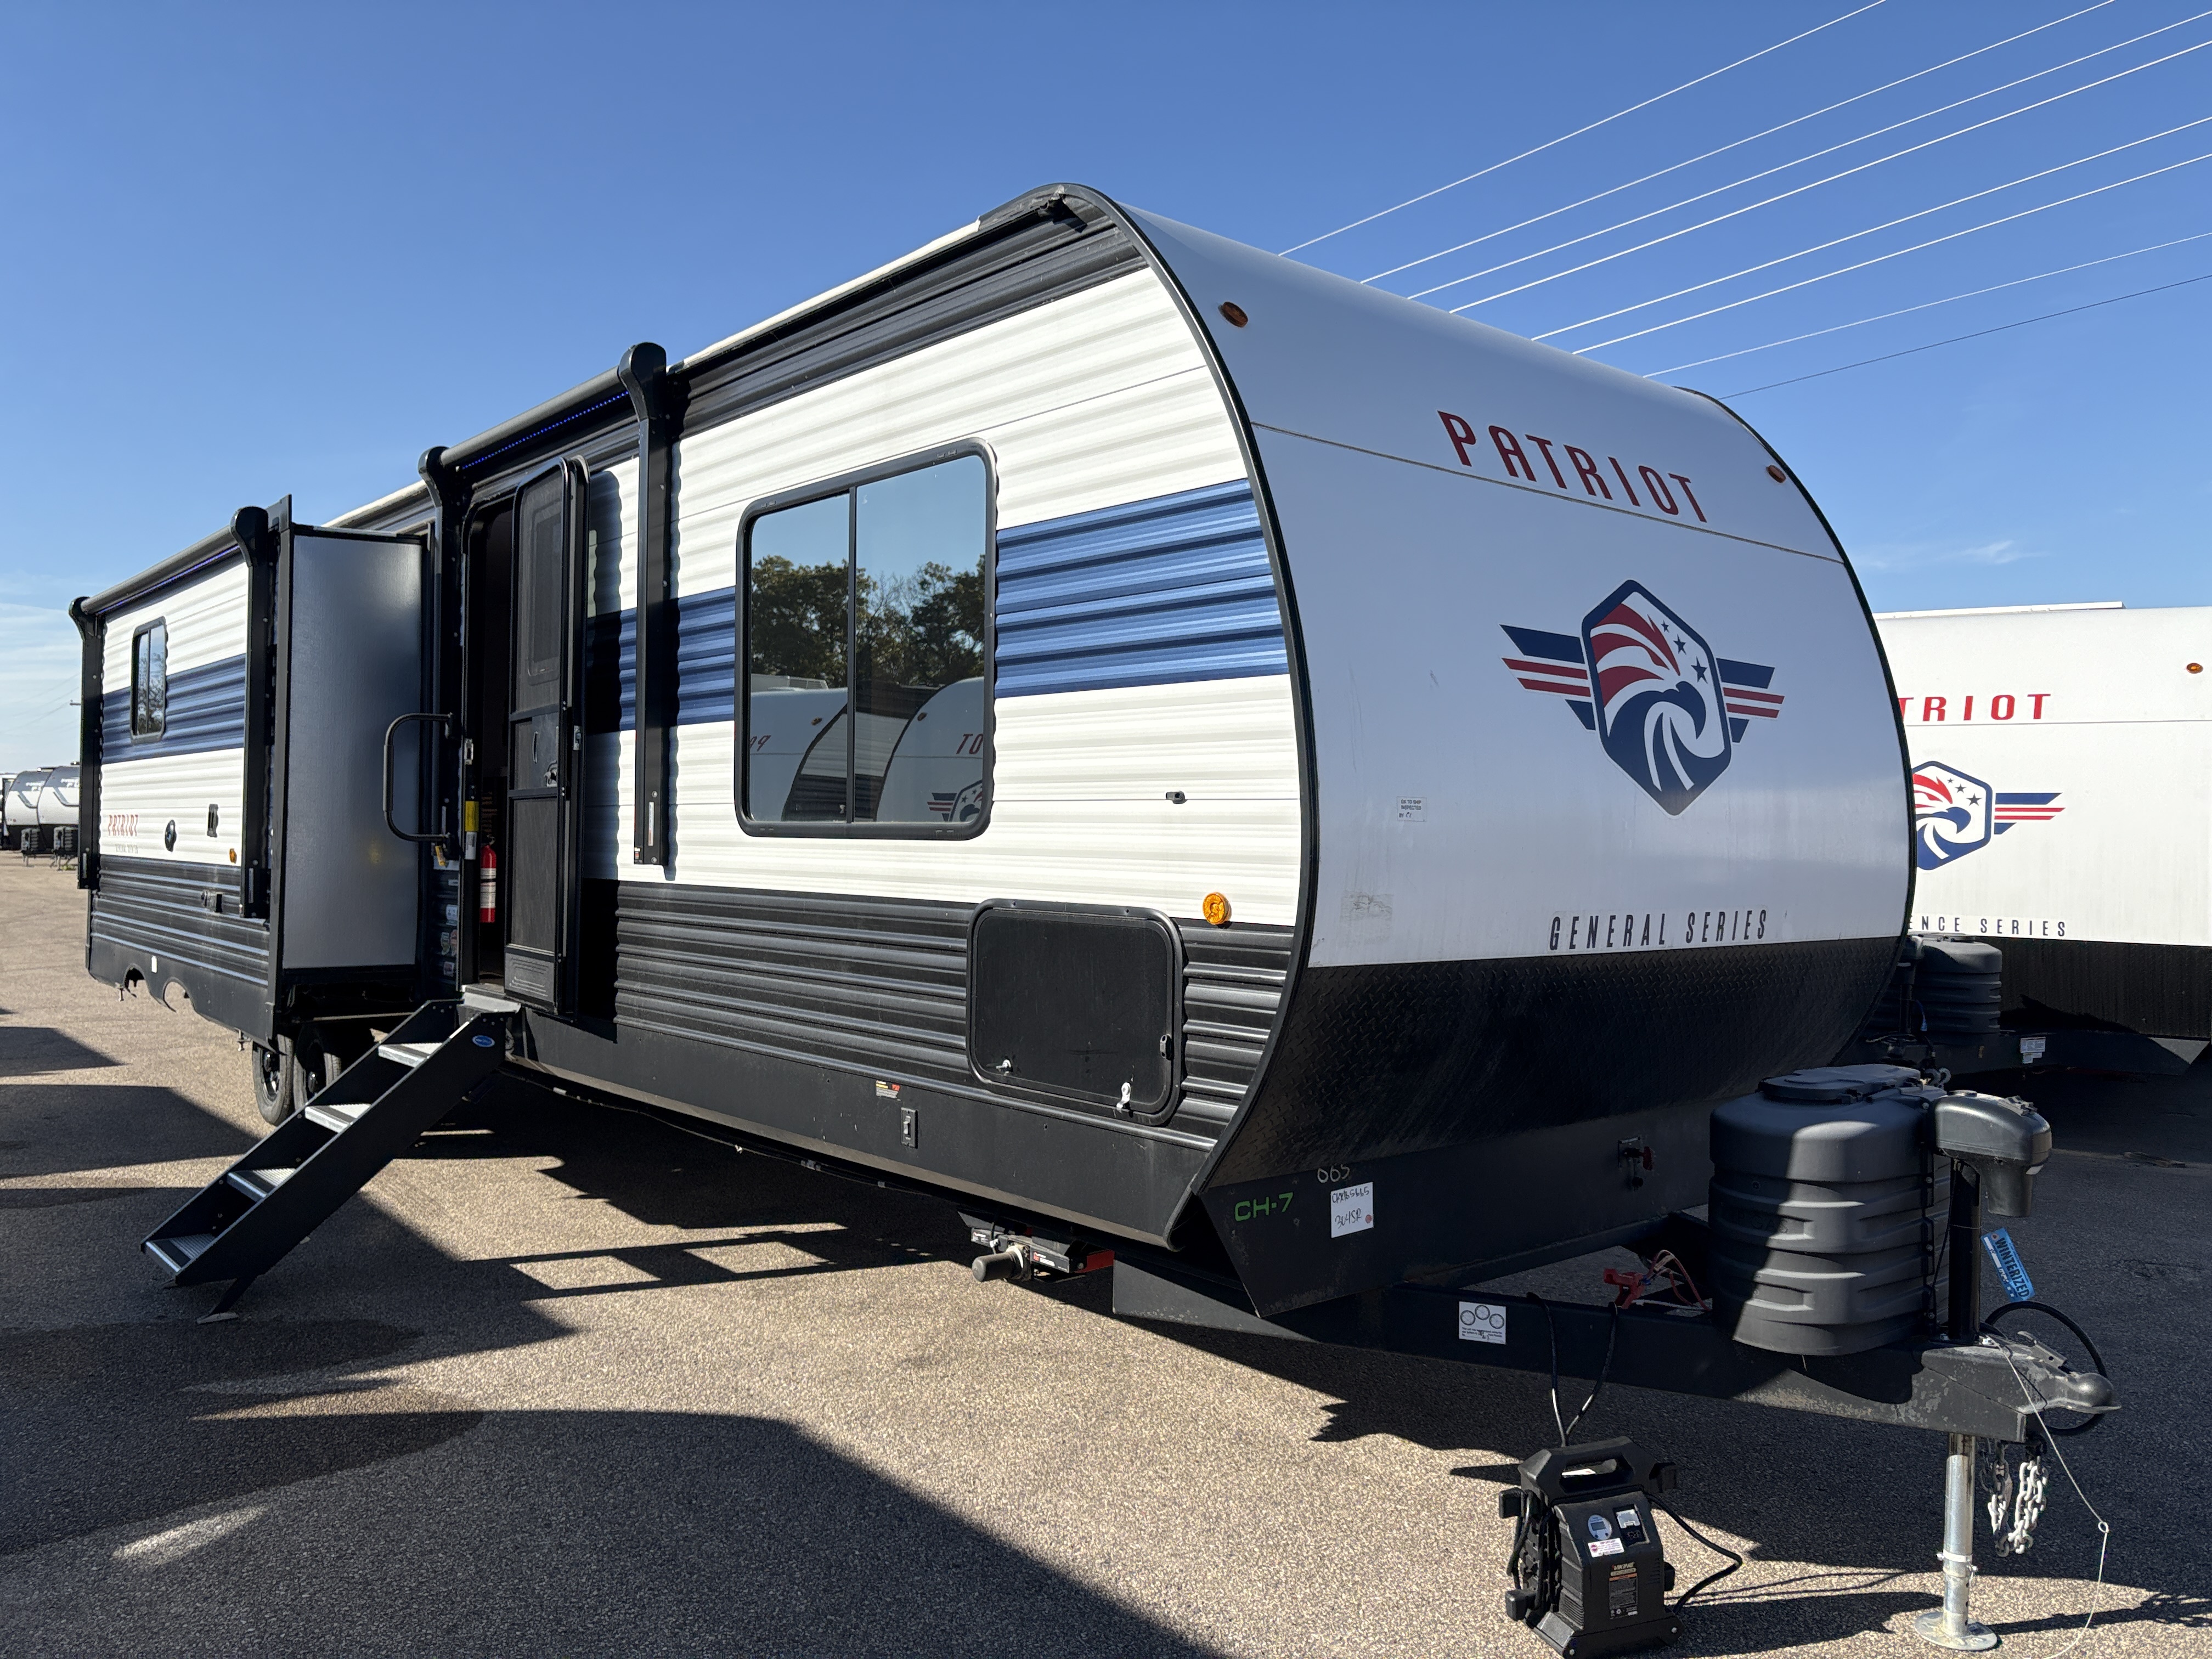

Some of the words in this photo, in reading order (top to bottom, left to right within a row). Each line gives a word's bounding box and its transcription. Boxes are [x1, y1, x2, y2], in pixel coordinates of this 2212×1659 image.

[1437, 410, 1707, 523] PATRIOT
[108, 814, 139, 837] PATRIOT
[1549, 913, 1666, 951] GENERAL
[1686, 910, 1767, 944] SERIES
[1980, 918, 2065, 936] SERIES
[1995, 1237, 2030, 1297] WINTERIZED
